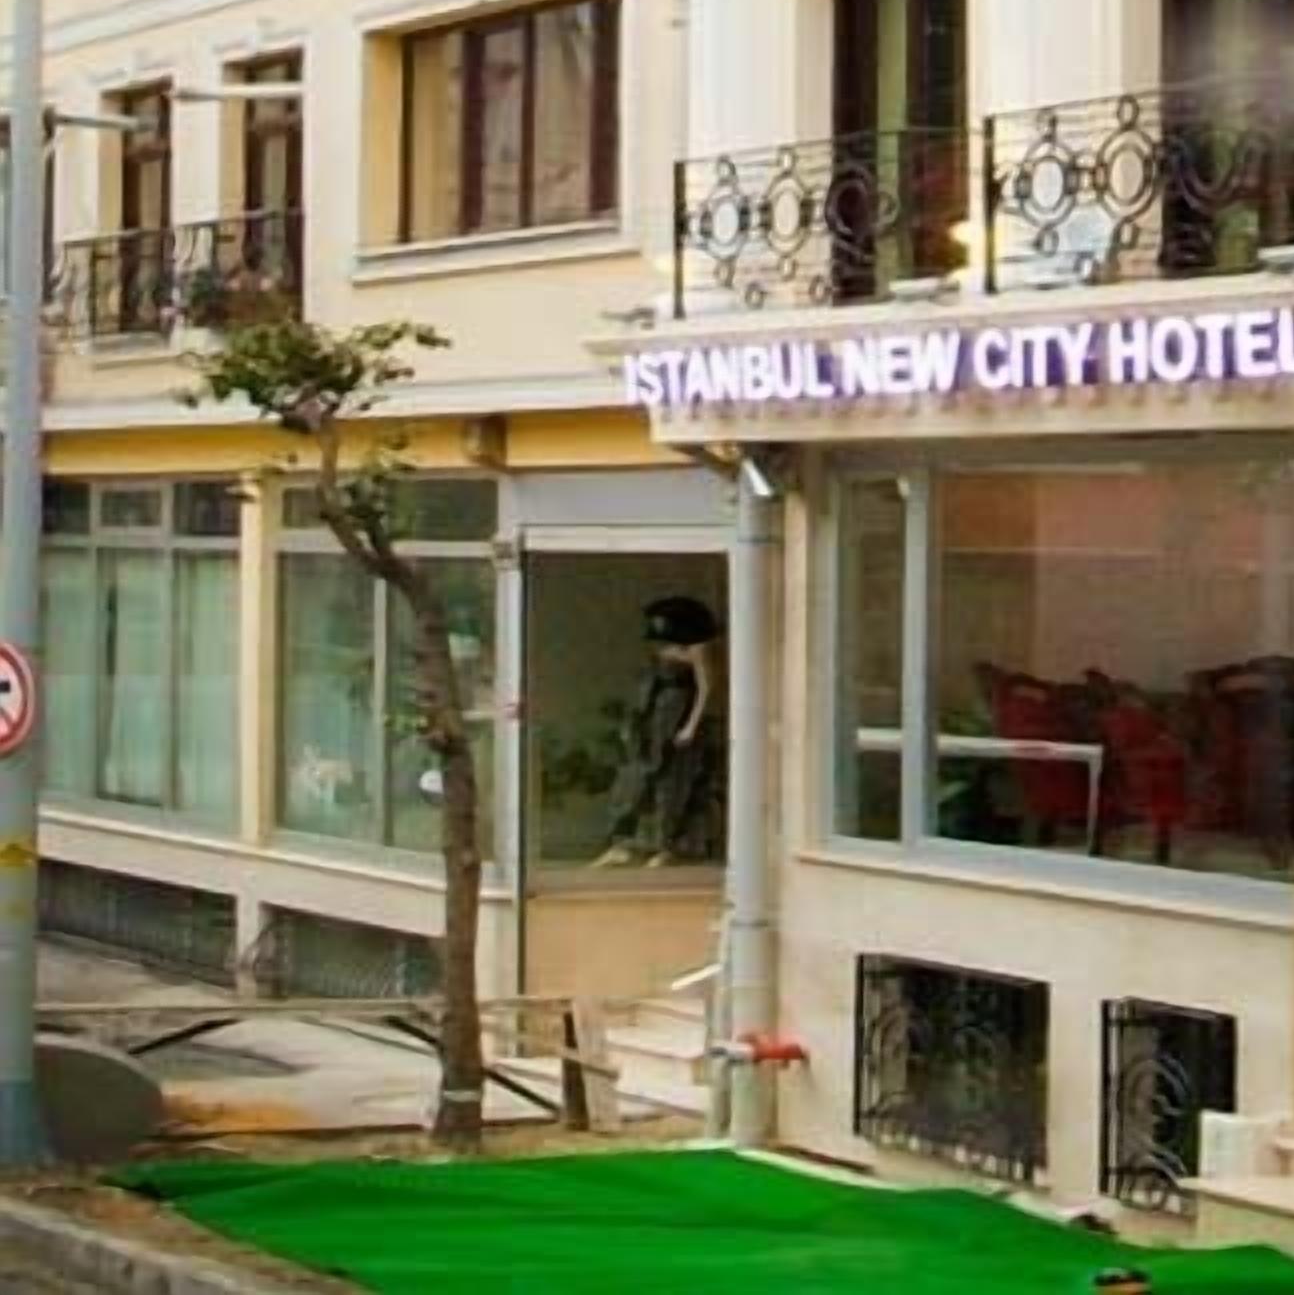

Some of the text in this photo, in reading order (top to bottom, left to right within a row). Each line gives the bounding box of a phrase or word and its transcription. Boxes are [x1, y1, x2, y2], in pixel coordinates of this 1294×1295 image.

[623, 342, 833, 406] ISTANBUL
[840, 328, 959, 396] NEW
[973, 322, 1096, 388] CITY
